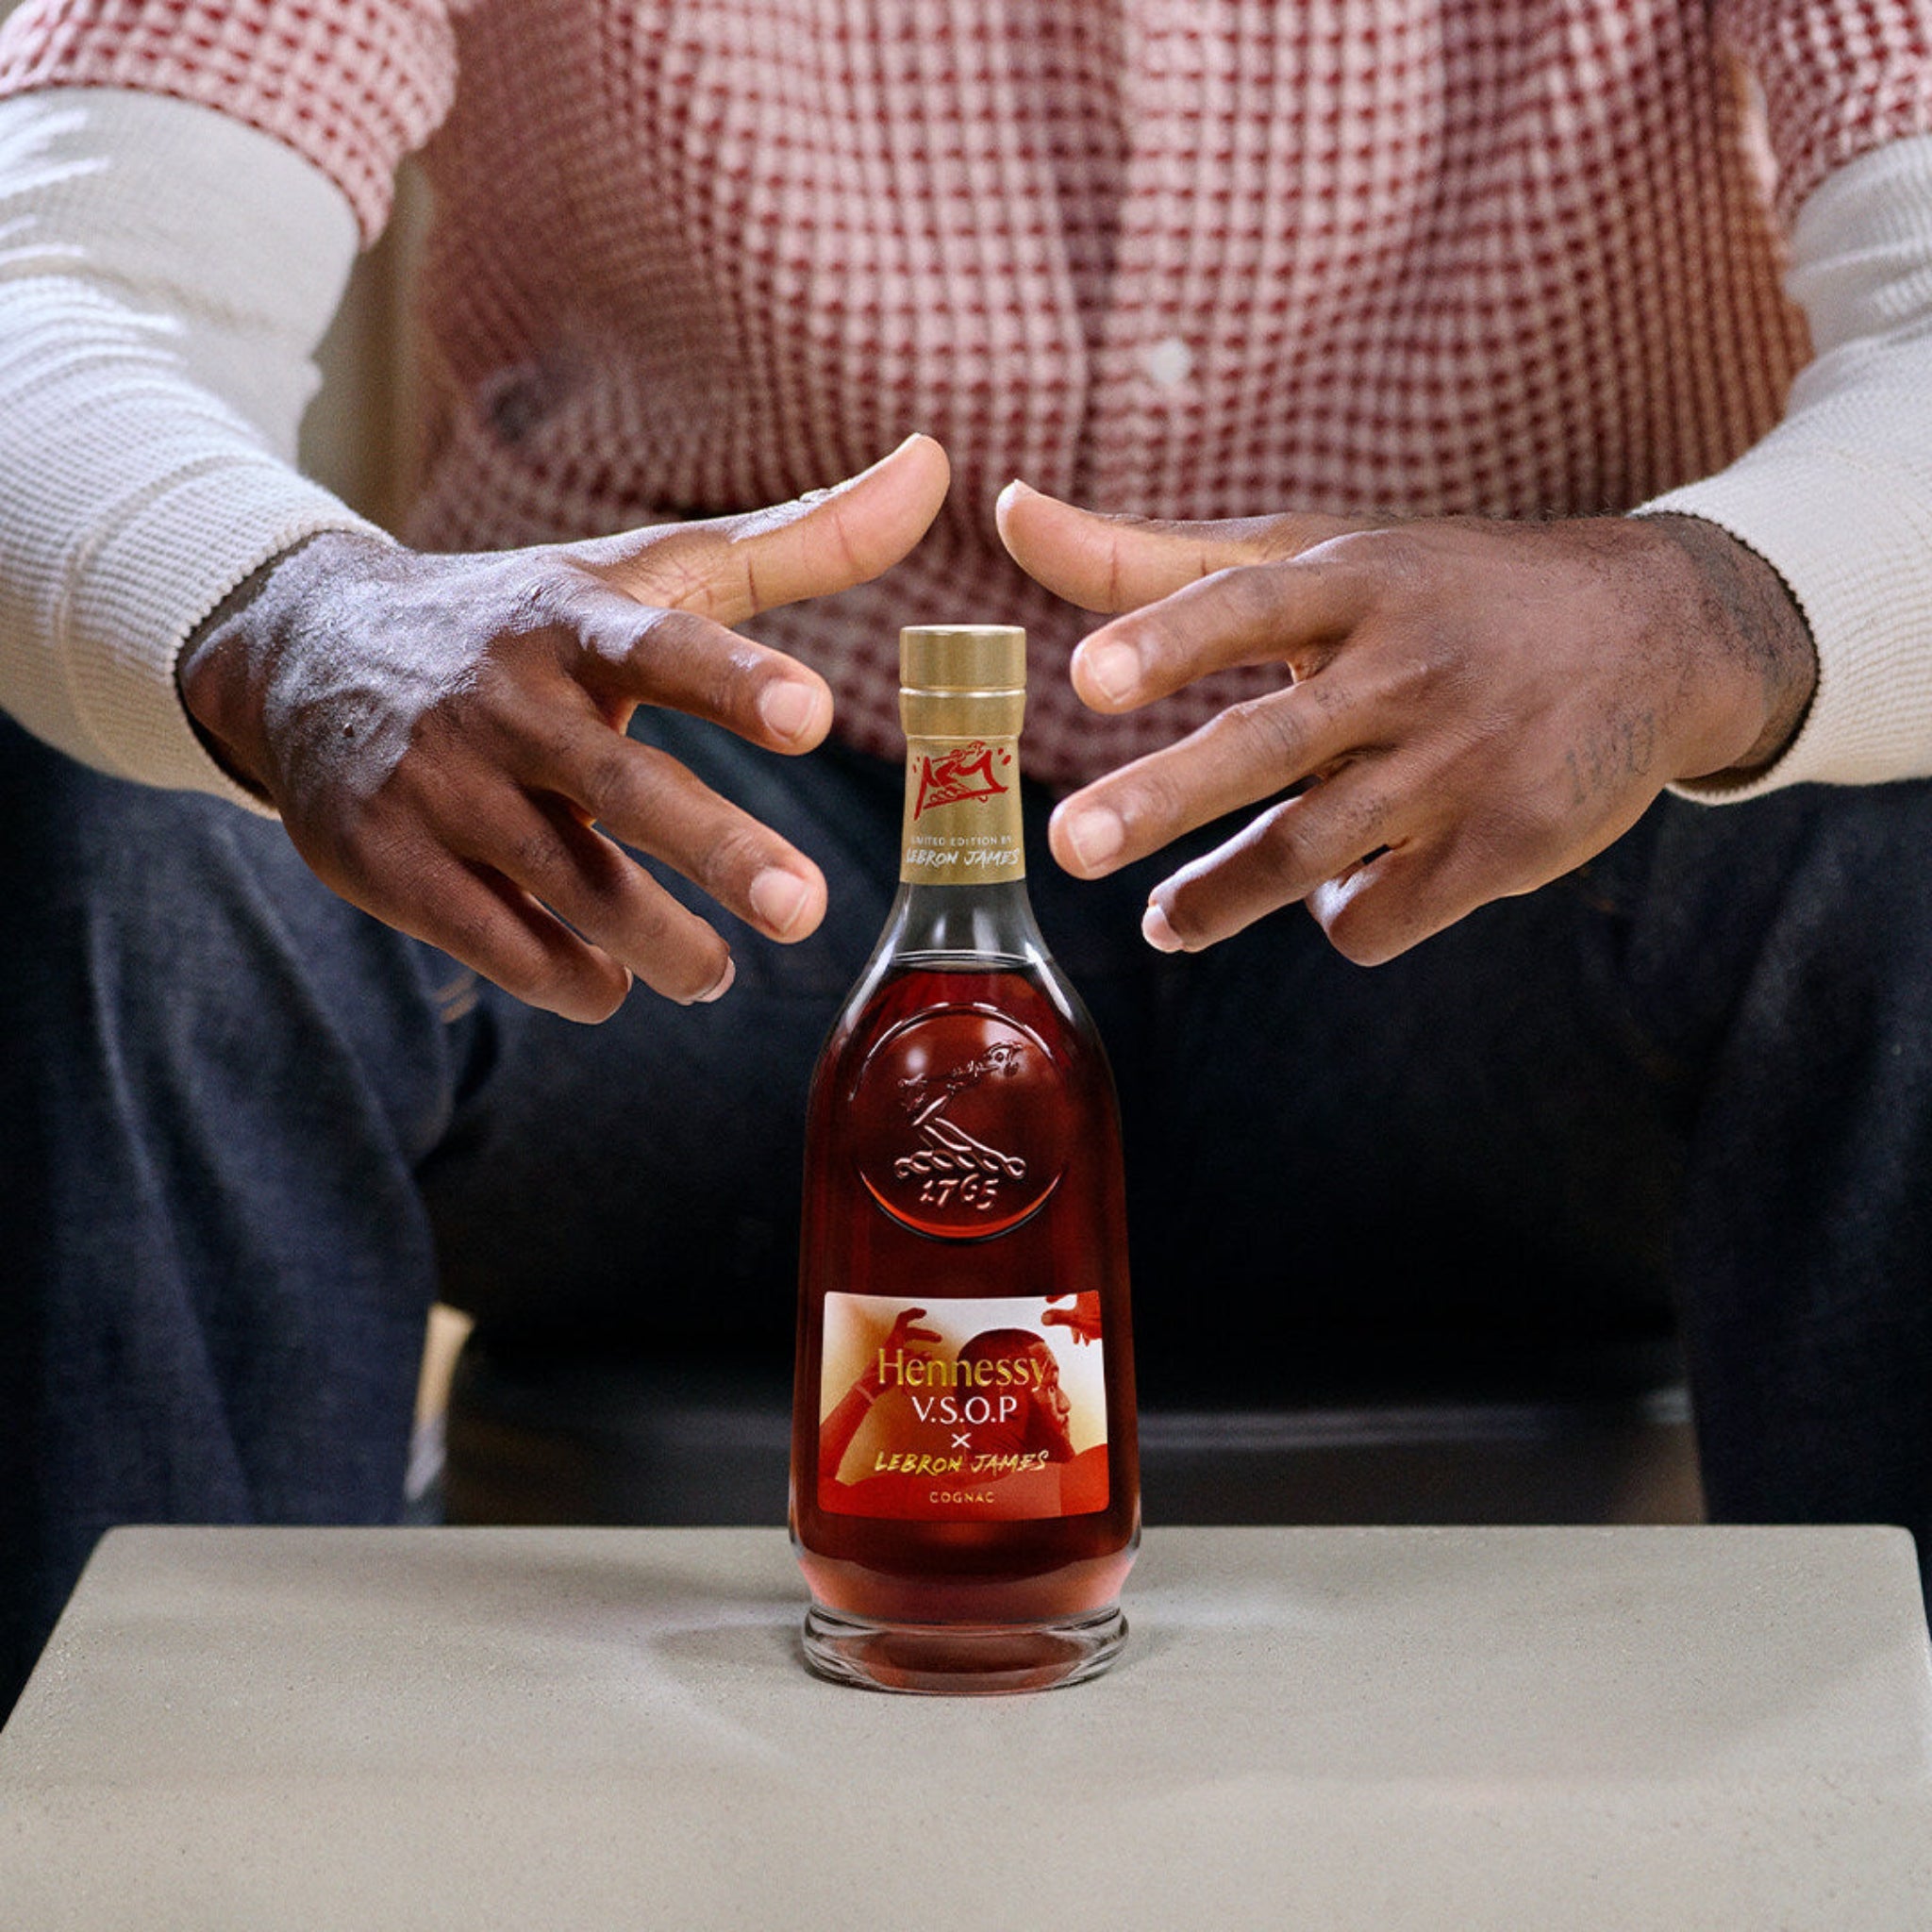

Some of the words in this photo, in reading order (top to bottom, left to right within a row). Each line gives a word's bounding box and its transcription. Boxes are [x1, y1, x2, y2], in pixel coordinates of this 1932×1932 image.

[950, 835, 997, 847] EDITION
[1001, 834, 1012, 844] BY
[906, 848, 958, 867] LEBRON
[964, 848, 1020, 869] JAMES
[920, 1174, 999, 1209] 1765
[878, 1348, 1044, 1392] Hennessy
[911, 1396, 1018, 1424] V.S.O.P
[874, 1452, 964, 1475] LEBRON
[970, 1450, 1049, 1474] JAMES
[929, 1491, 995, 1504] COGNAC
